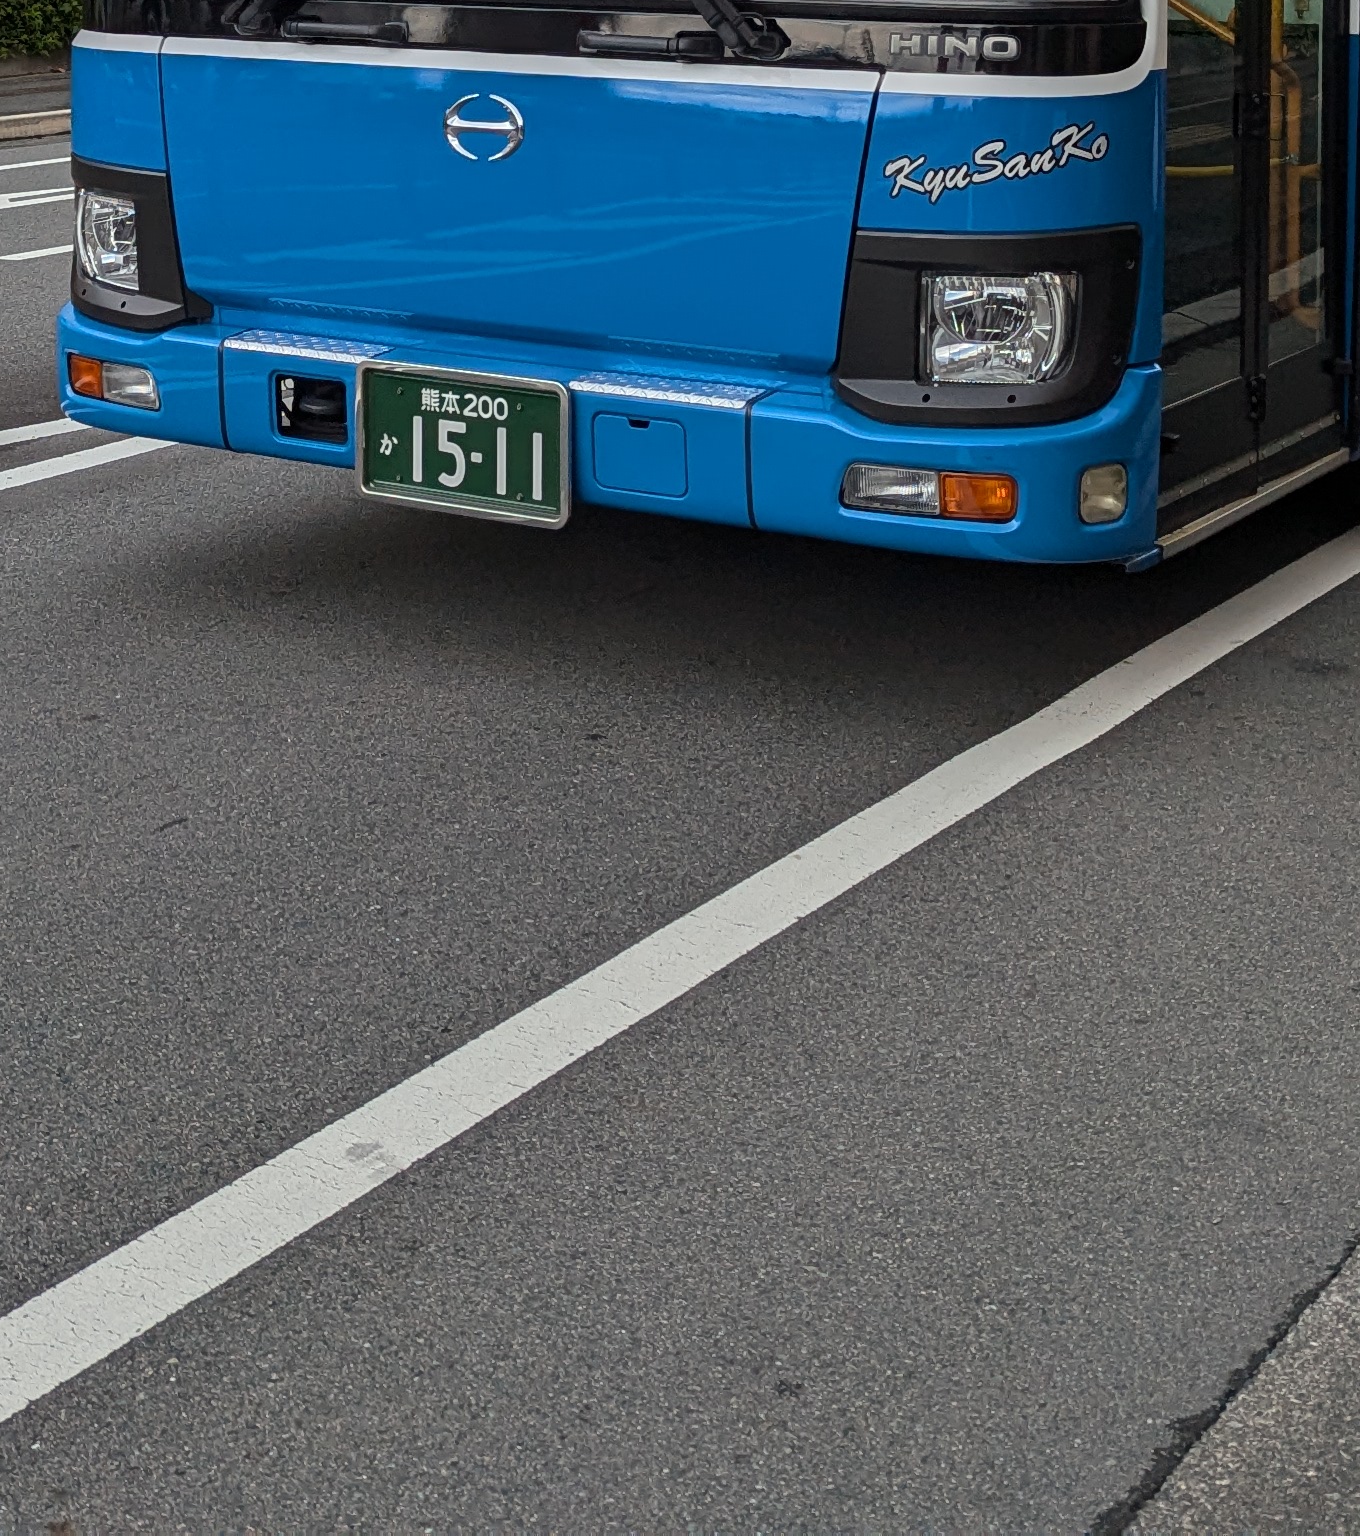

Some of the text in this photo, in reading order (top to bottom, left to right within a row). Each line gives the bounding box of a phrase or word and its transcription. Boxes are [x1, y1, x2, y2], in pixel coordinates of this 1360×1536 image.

[890, 34, 1021, 61] HINO
[883, 122, 1110, 205] KyuSanKo
[421, 387, 508, 421] 熊本200
[380, 415, 543, 501] か 15-11
